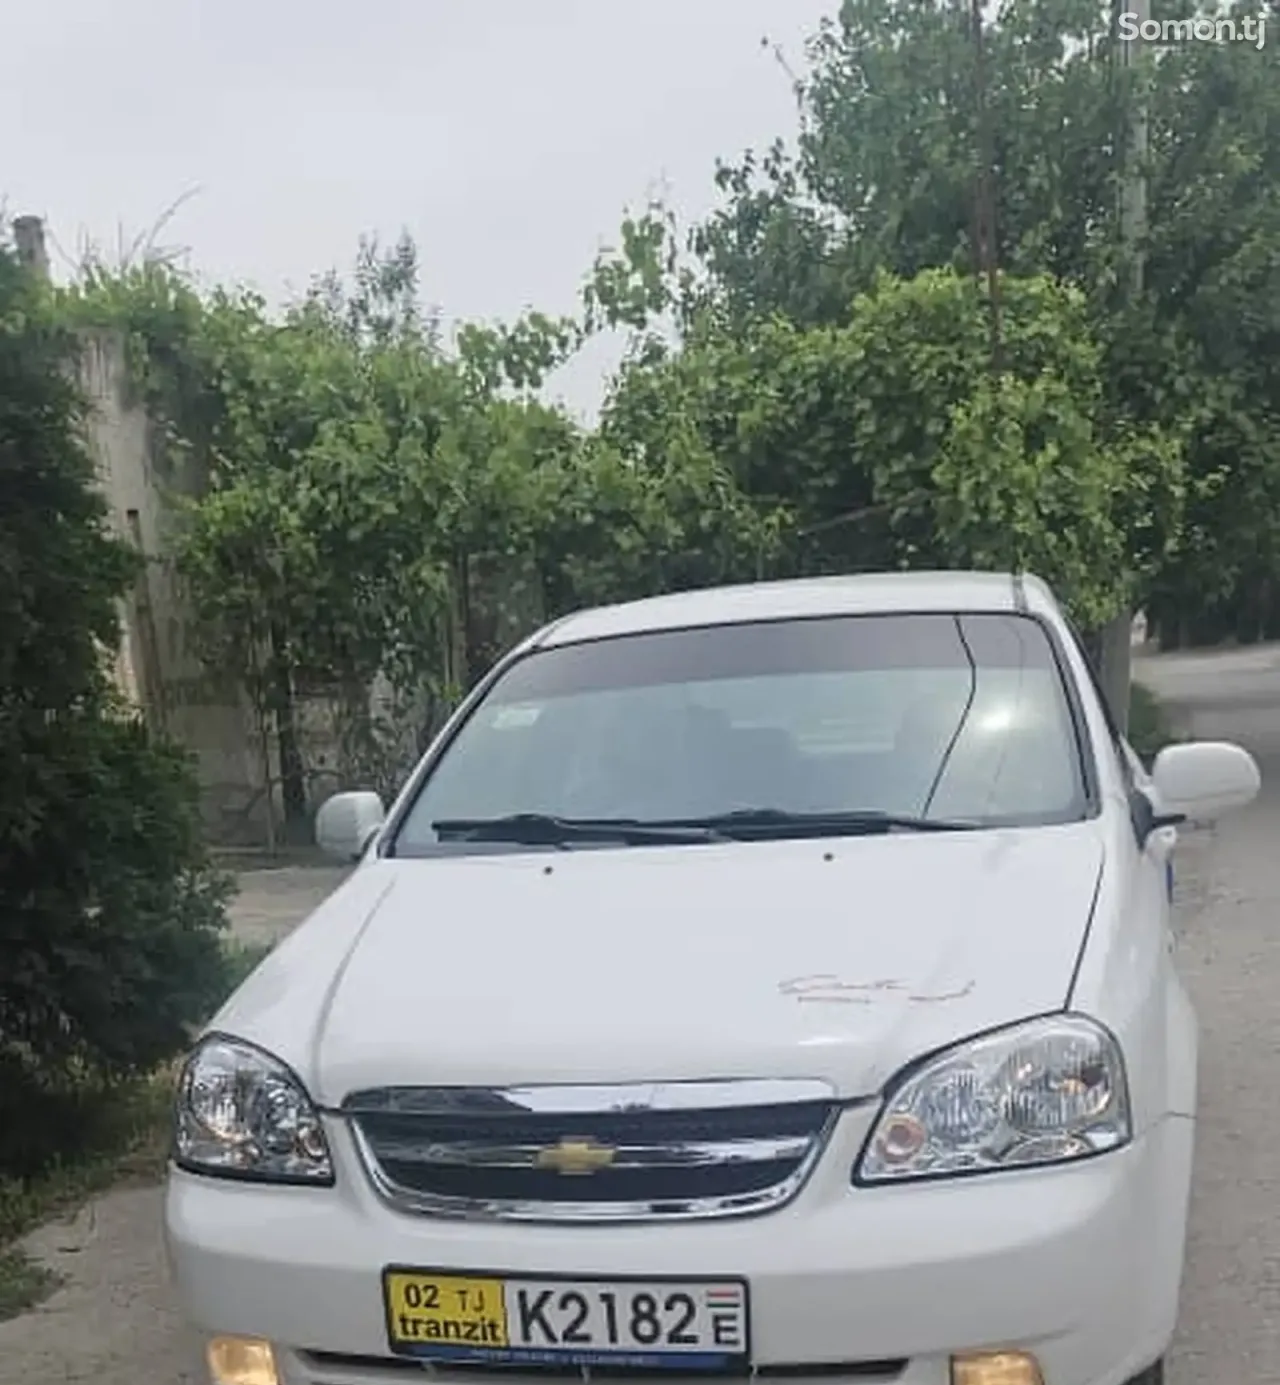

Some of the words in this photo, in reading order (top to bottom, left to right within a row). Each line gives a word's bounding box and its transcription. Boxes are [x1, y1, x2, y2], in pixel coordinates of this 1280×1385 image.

[404, 1283, 440, 1309] 02
[457, 1289, 485, 1313] TJ
[399, 1313, 501, 1342] tranzit
[517, 1289, 699, 1344] K2182
[712, 1313, 740, 1345] E
